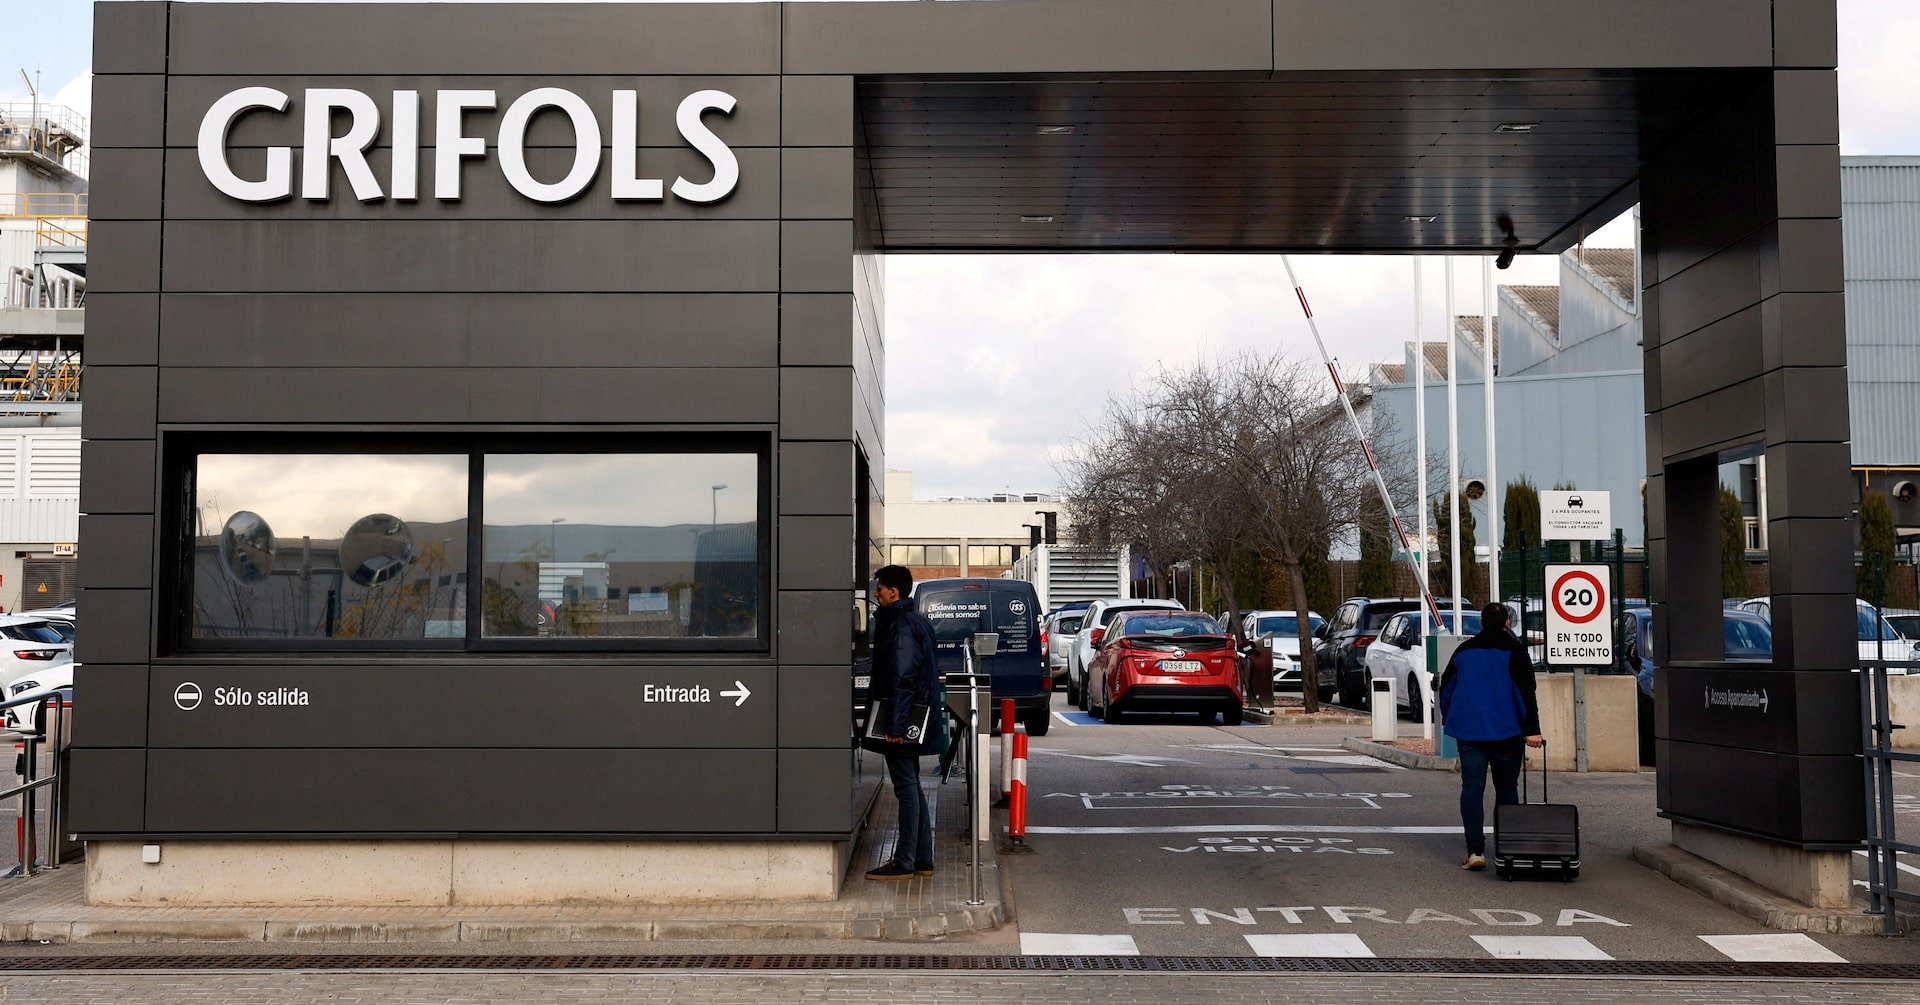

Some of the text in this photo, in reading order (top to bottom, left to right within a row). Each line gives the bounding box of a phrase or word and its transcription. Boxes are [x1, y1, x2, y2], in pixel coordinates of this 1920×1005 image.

[197, 86, 740, 203] GRIFOLS
[1564, 588, 1592, 606] 20
[928, 612, 954, 620] quiénes
[1557, 633, 1603, 642] EN TODO
[1550, 648, 1610, 657] EL RECINTO
[1164, 661, 1183, 670] 0358
[214, 686, 310, 706] Sólo salida
[644, 684, 711, 702] Entrada
[1711, 688, 1727, 704] Acceso
[1198, 836, 1353, 844] STOP
[1159, 846, 1395, 855] VISITAS
[1122, 906, 1632, 927] ENTRADA
